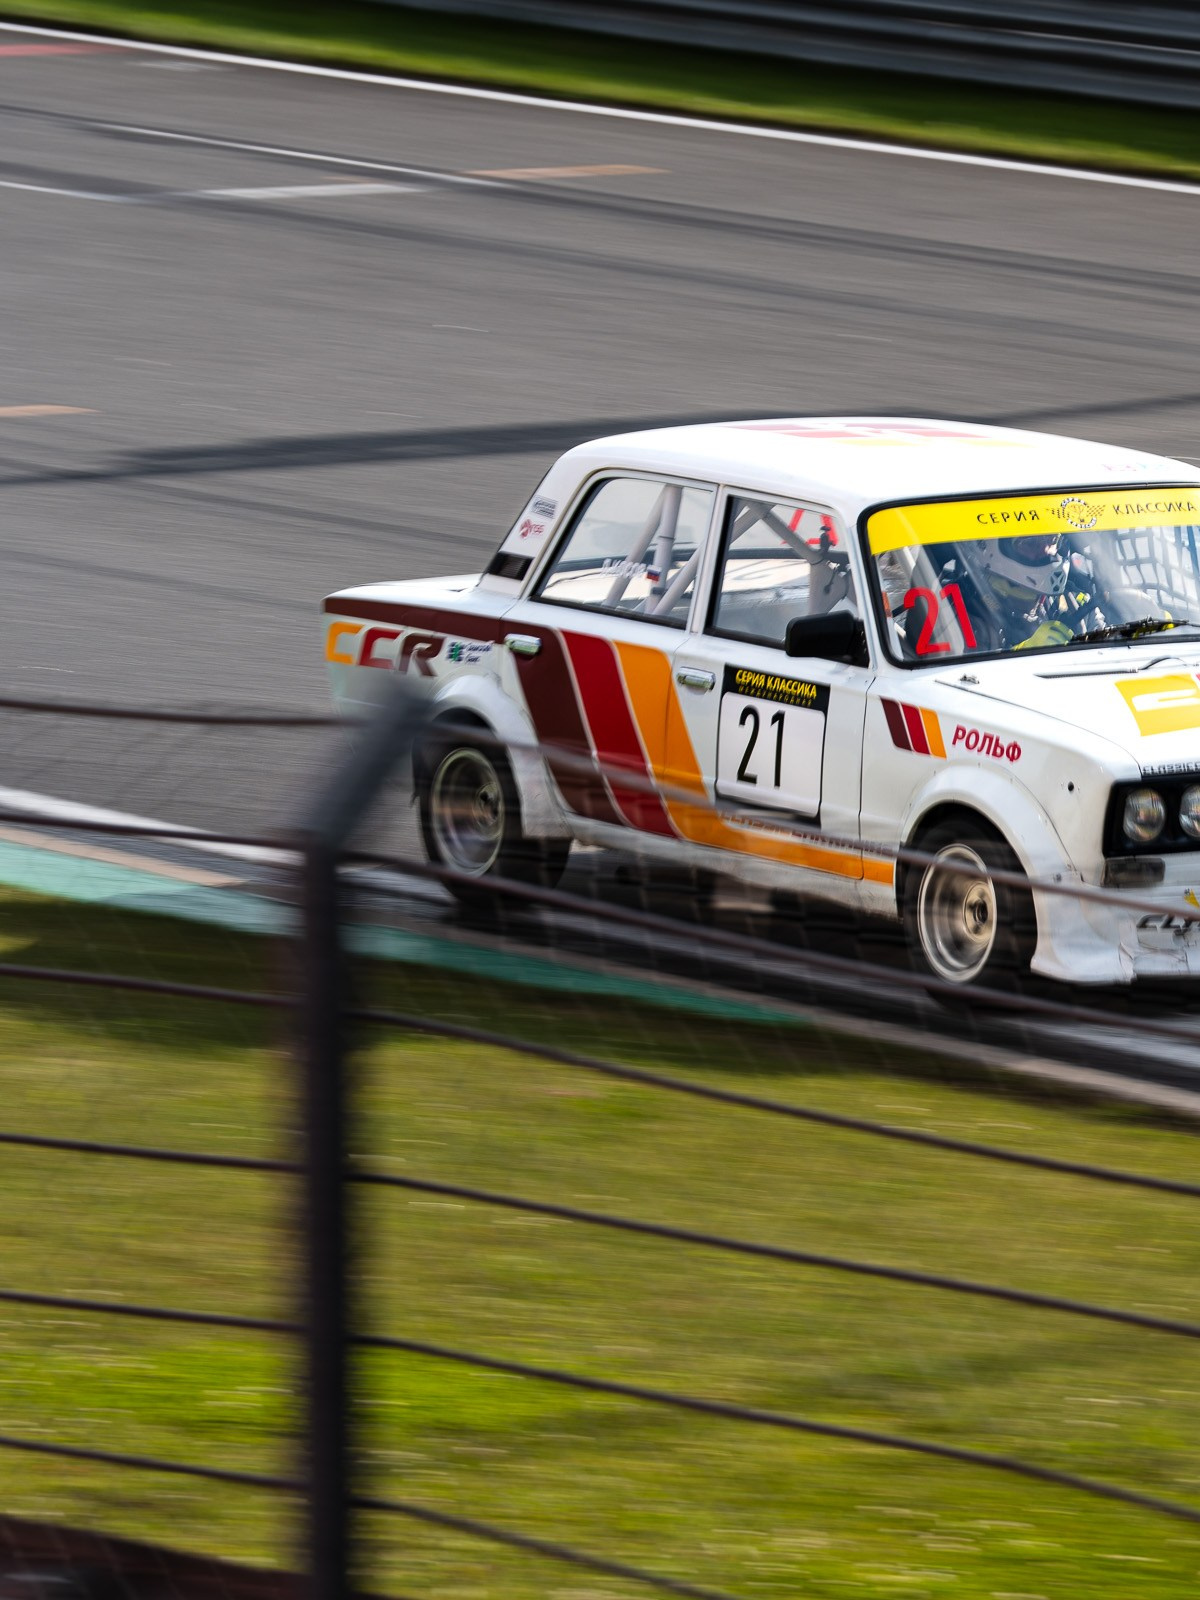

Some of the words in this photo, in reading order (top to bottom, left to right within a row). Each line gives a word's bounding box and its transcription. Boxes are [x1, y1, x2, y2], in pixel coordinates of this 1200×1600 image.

[976, 509, 1041, 525] СЕРИЯ
[1112, 501, 1198, 516] КЛАССИКА
[903, 583, 977, 656] 21
[326, 621, 446, 677] CCR
[735, 669, 766, 687] СЕРИЯ
[766, 676, 818, 700] КЛАССИКА
[737, 704, 786, 788] 21
[952, 724, 1022, 762] РОЛЬФ
